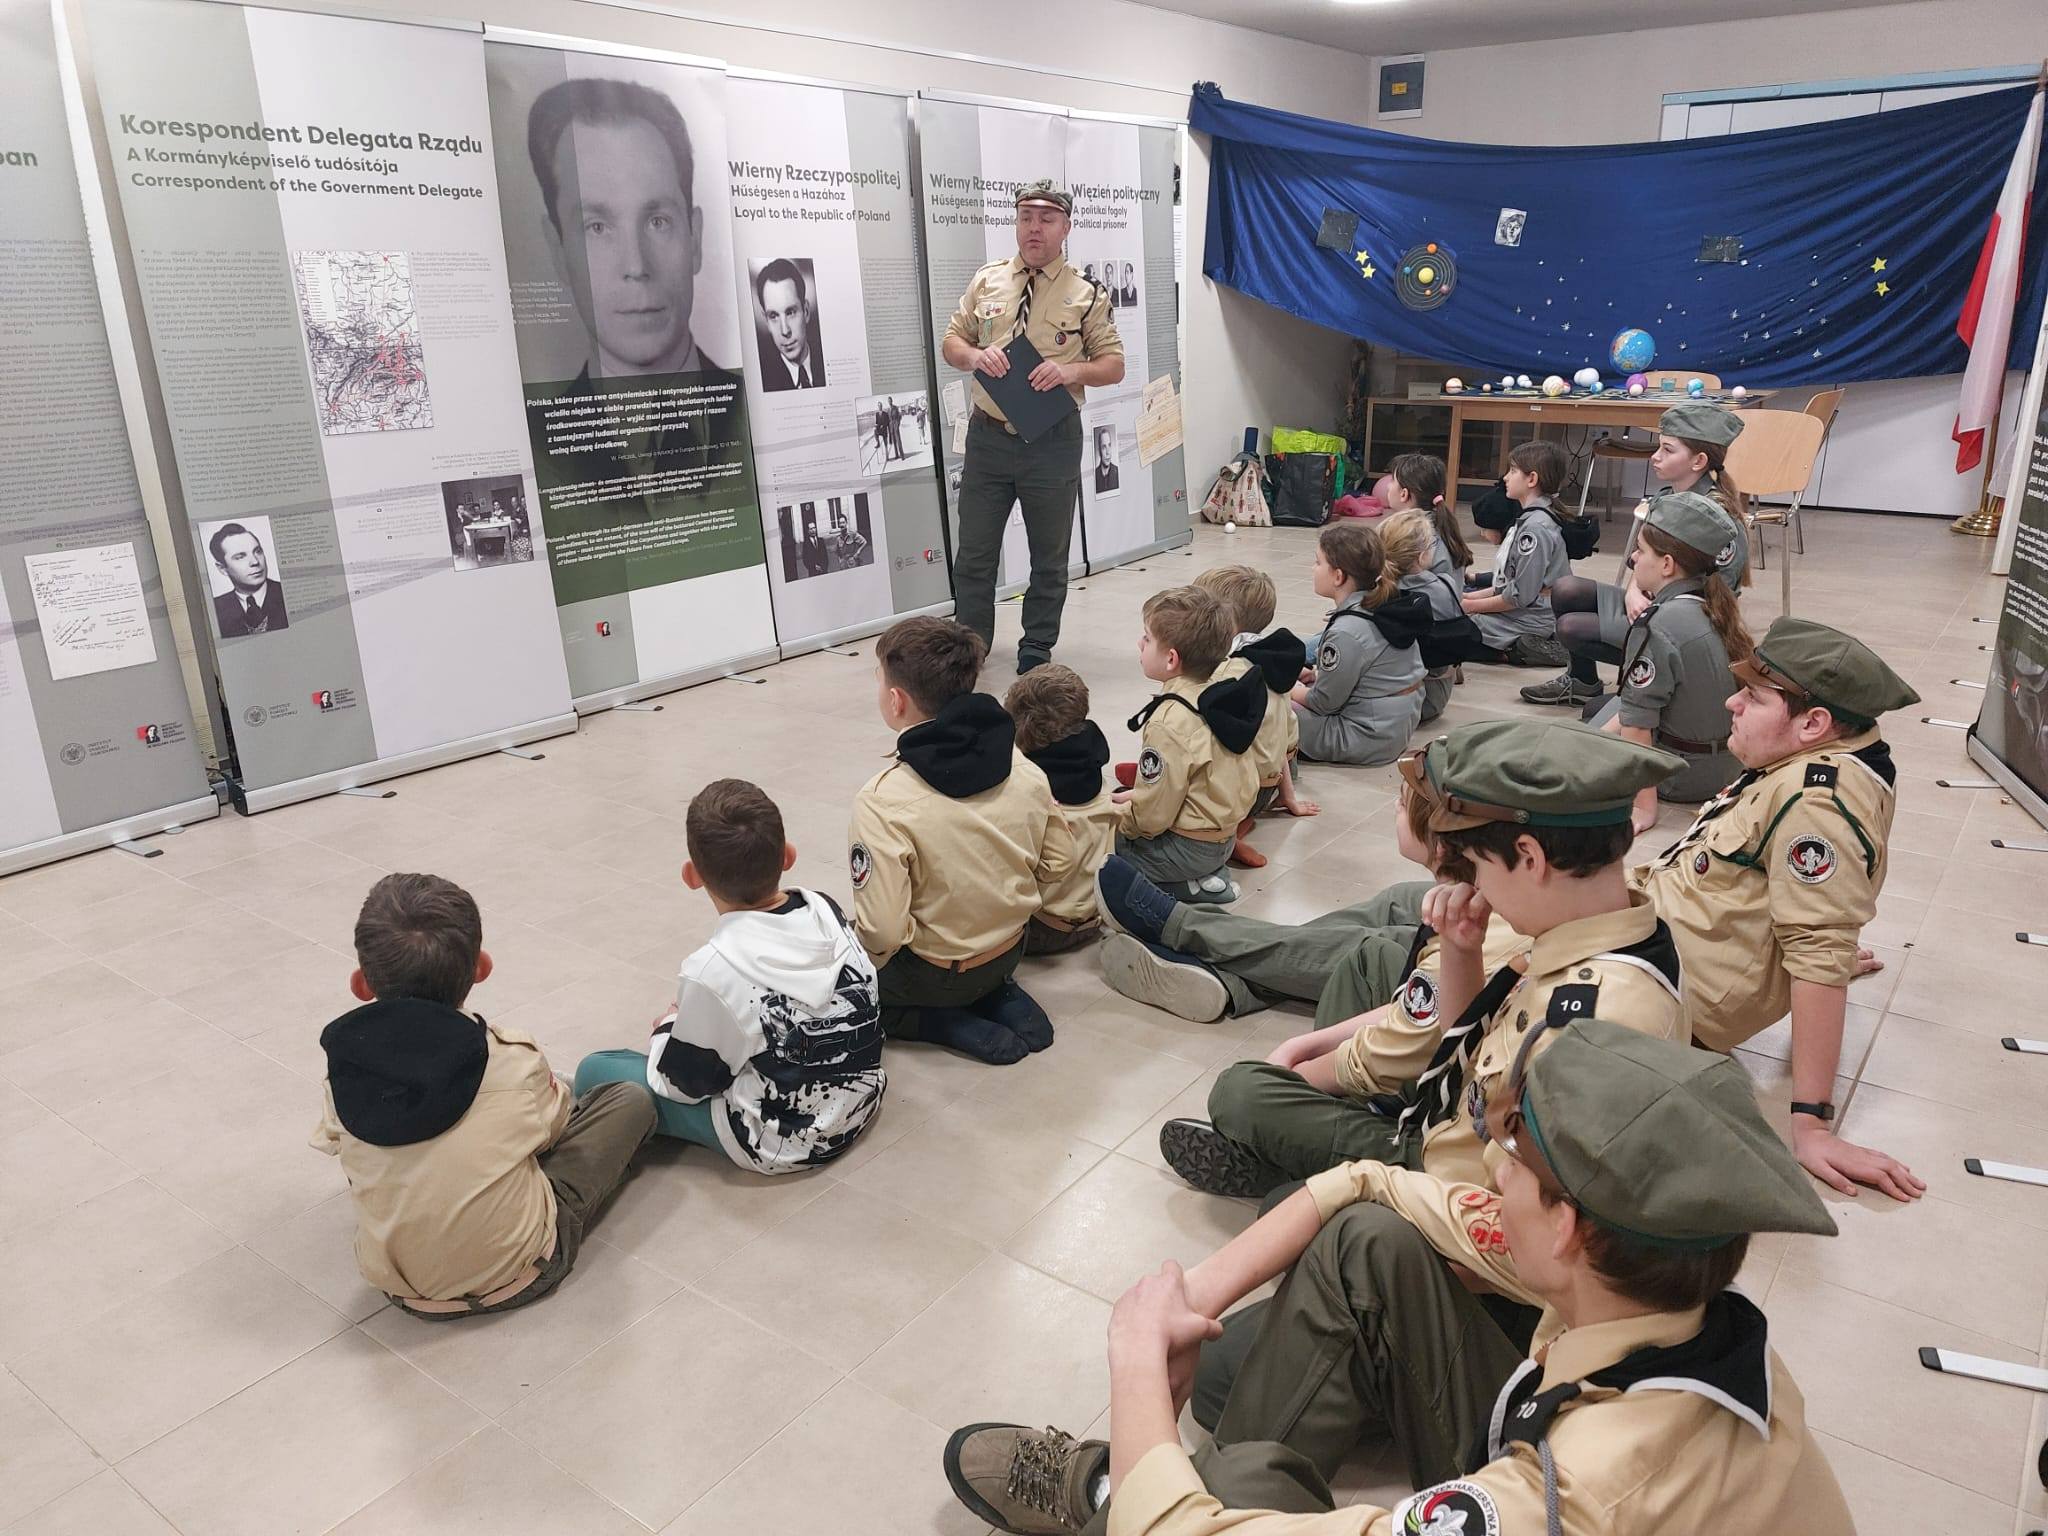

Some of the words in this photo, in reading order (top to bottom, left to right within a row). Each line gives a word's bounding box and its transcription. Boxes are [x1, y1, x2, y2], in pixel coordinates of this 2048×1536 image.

[120, 114, 302, 143] Korespondent
[307, 126, 413, 152] Delegata
[418, 132, 482, 156] Rządu
[127, 147, 140, 162] A
[144, 148, 310, 170] Kormányképviselő
[314, 156, 398, 176] tudósítója
[728, 161, 782, 183] Wierny
[786, 164, 901, 190] Rzeczypospolitej
[930, 174, 970, 193] Wierny
[131, 172, 266, 191] Correspondent
[269, 178, 285, 192] of
[290, 179, 317, 192] the
[321, 180, 415, 196] Government
[418, 184, 483, 200] Delegate
[731, 184, 790, 200] Hűségesen
[793, 190, 799, 199] a
[802, 188, 846, 201] Hazához
[1071, 184, 1111, 202] Więzień
[1112, 186, 1160, 204] polityczny
[734, 206, 766, 221] Loyal
[769, 208, 780, 219] to
[782, 208, 798, 220] the
[800, 208, 844, 222] Republic
[846, 210, 856, 221] of
[858, 210, 890, 222] Poland
[1073, 206, 1079, 214] A
[932, 213, 958, 227] Loyal
[960, 214, 970, 224] to
[970, 214, 984, 225] the
[1073, 219, 1101, 229] Political
[1102, 219, 1128, 230] prisoner
[527, 398, 554, 407] Polska,
[555, 397, 572, 405] która
[574, 395, 593, 404] przez
[608, 390, 658, 400] antyniemieckie
[571, 407, 596, 416] niejako
[604, 404, 624, 412] siebie
[595, 428, 618, 437] ludami
[570, 444, 593, 453] Europę
[1812, 774, 1827, 782] 10
[1560, 1000, 1582, 1011] 10
[1517, 1401, 1538, 1418] 10
